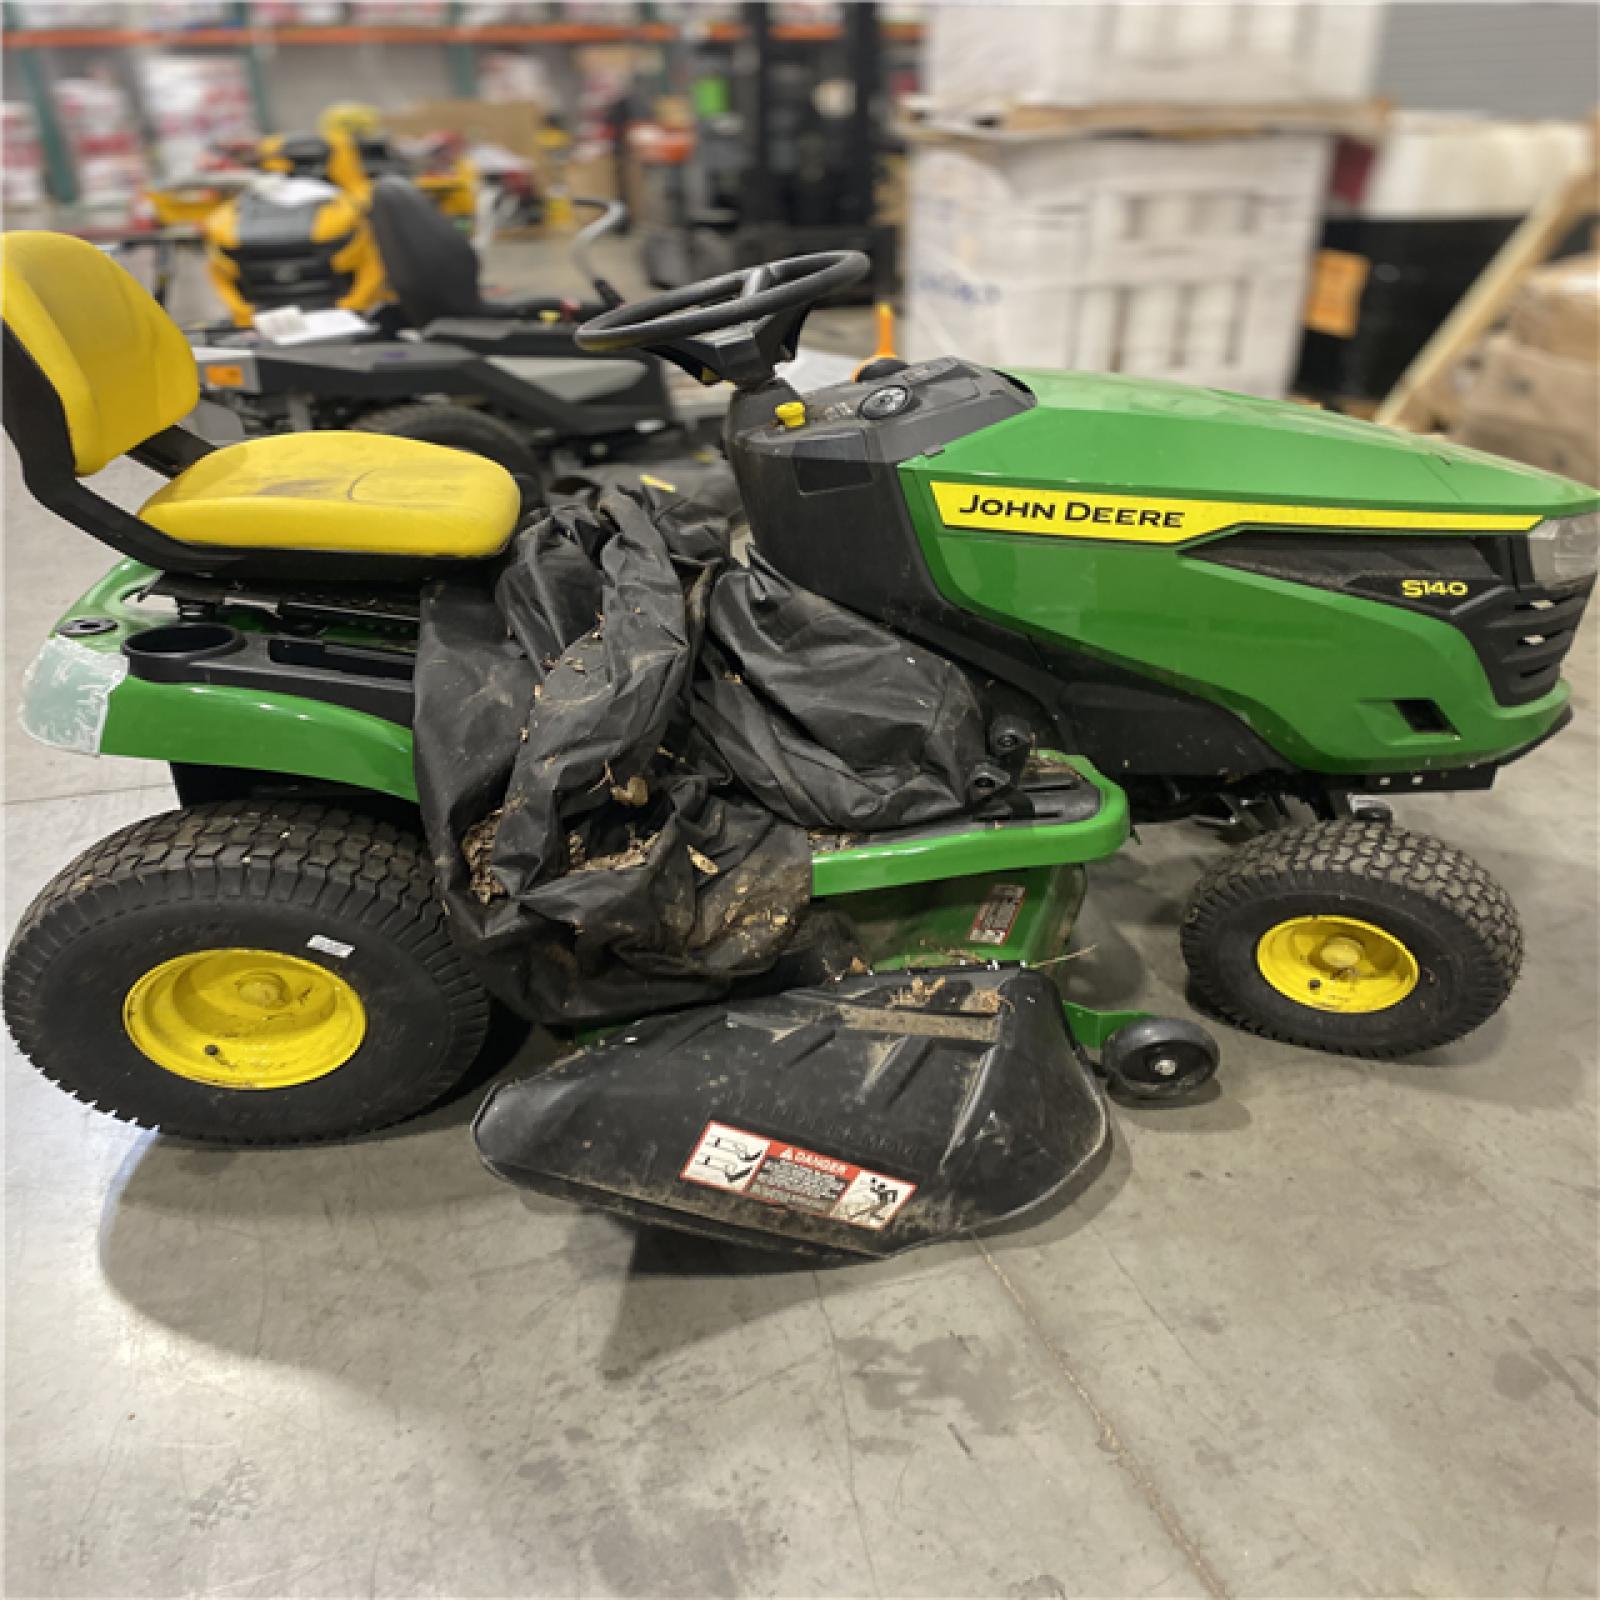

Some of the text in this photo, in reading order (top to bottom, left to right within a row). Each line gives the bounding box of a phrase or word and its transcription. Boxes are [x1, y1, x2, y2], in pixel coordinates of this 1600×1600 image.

[959, 494, 1186, 528] JOHN DEERE
[1401, 579, 1469, 598] S140
